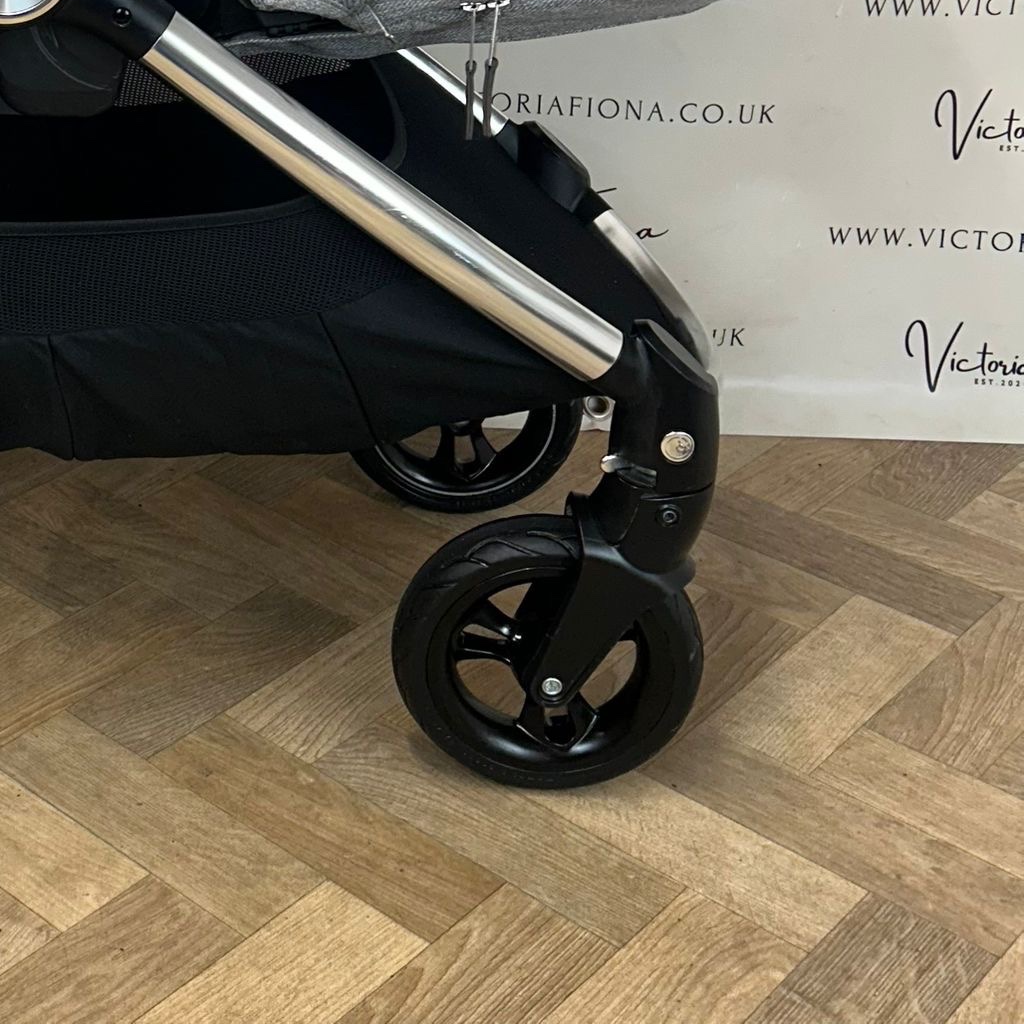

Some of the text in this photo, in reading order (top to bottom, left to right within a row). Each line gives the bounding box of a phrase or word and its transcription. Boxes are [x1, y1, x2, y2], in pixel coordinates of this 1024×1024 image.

[490, 92, 775, 125] ORIAFIONA.CO.UK
[934, 89, 1024, 160] Victo
[974, 377, 1022, 387] EST.202
